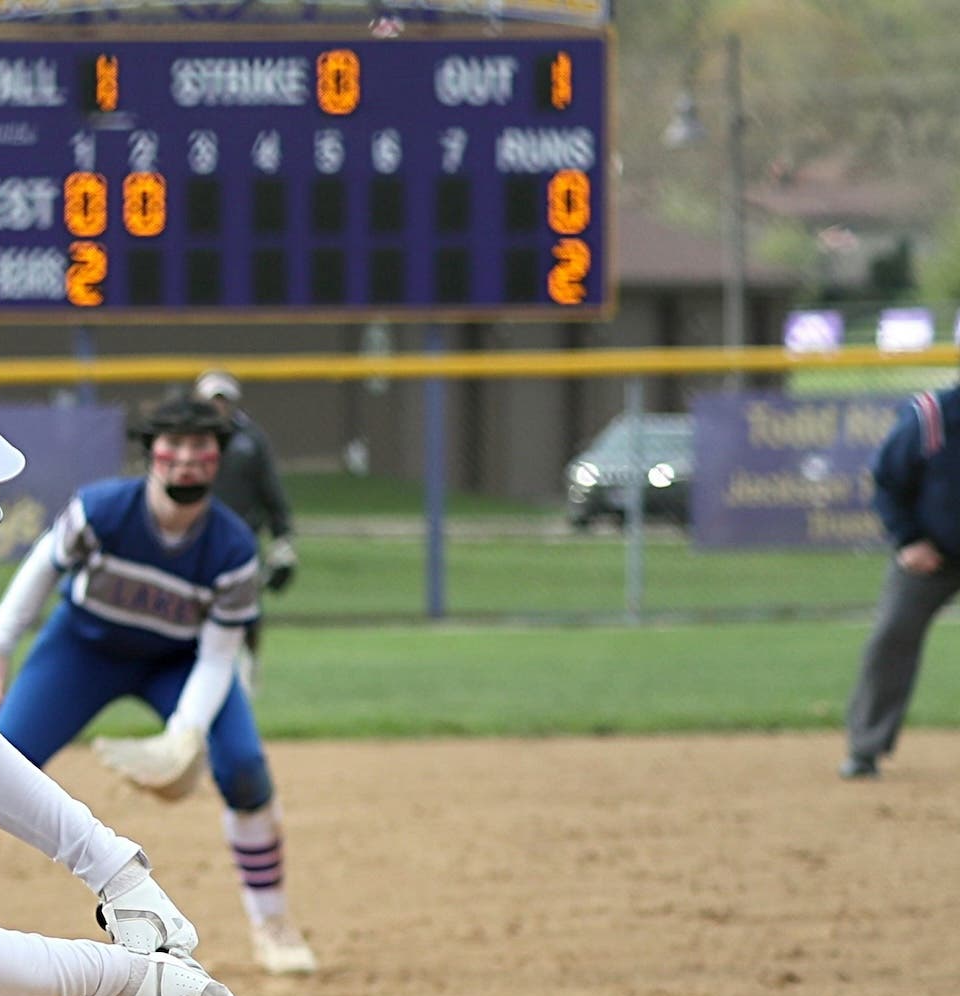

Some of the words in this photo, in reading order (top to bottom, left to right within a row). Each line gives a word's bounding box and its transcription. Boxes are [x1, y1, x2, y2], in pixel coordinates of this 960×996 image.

[171, 57, 309, 106] STRIKE
[317, 49, 360, 115] 0
[435, 56, 518, 106] OUT
[551, 51, 573, 110] 1
[70, 130, 97, 173] 1
[128, 130, 159, 173] 2
[188, 129, 218, 175] 3
[251, 129, 281, 175] 4
[313, 129, 345, 175] 5
[371, 128, 403, 174] 6
[438, 128, 468, 174] 7
[496, 126, 595, 173] RUNS
[64, 171, 107, 236] 0
[123, 172, 166, 236] 0
[548, 169, 590, 234] 0
[66, 240, 107, 306] 2
[548, 238, 590, 304] 2
